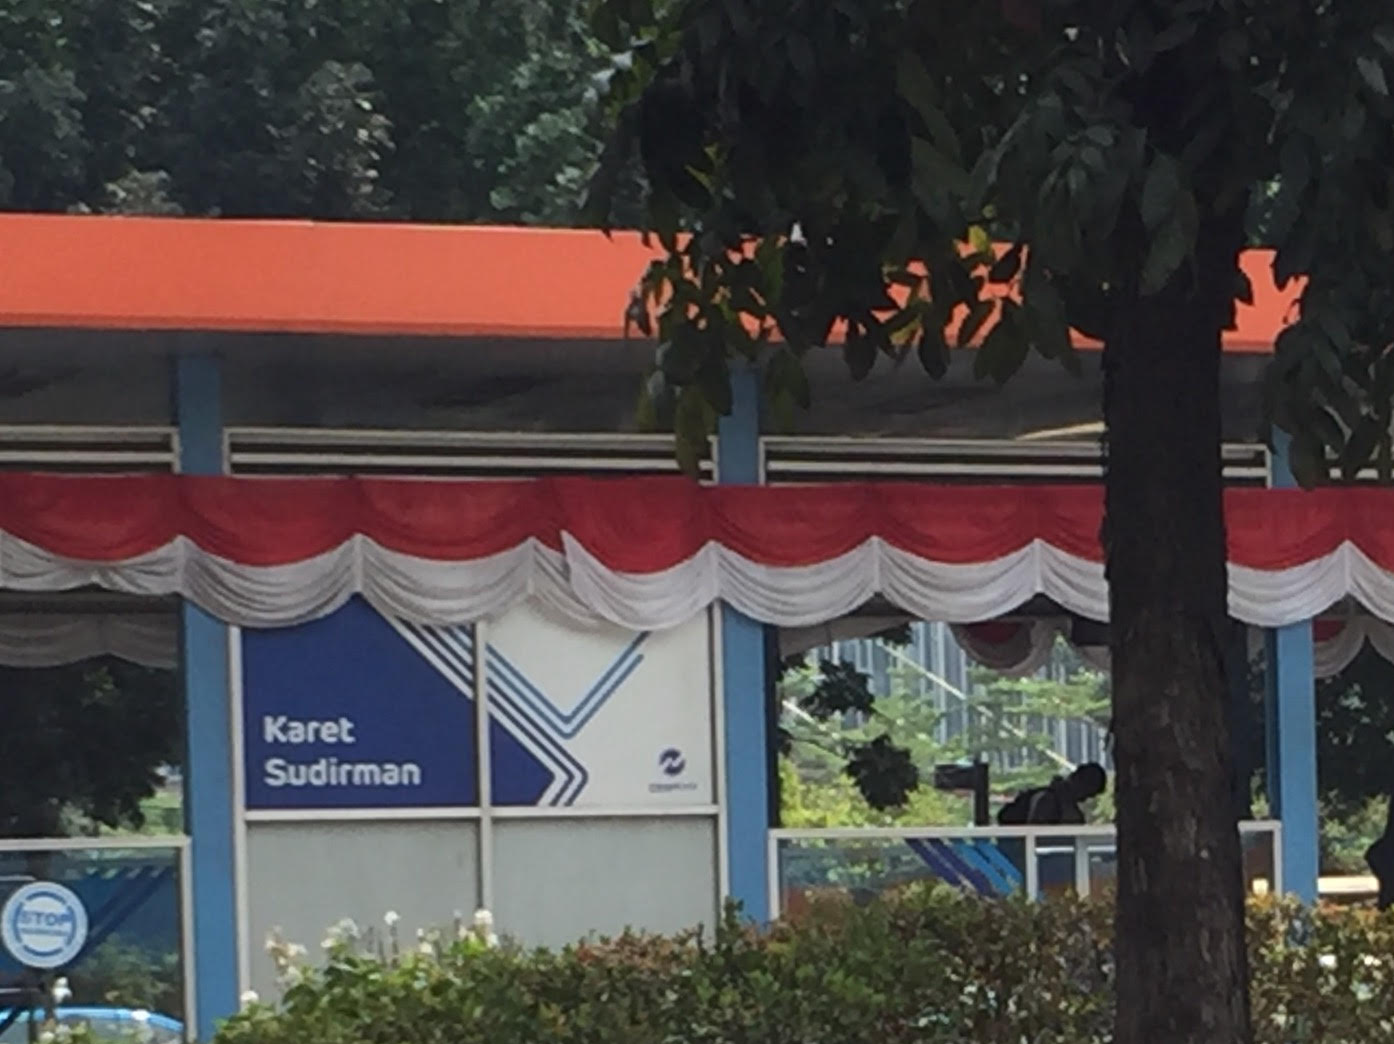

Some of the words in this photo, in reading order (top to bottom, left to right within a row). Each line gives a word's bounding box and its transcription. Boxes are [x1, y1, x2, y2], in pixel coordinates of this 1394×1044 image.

[263, 715, 356, 744] Karet
[263, 757, 422, 787] Sudirman
[20, 911, 73, 926] STOP
